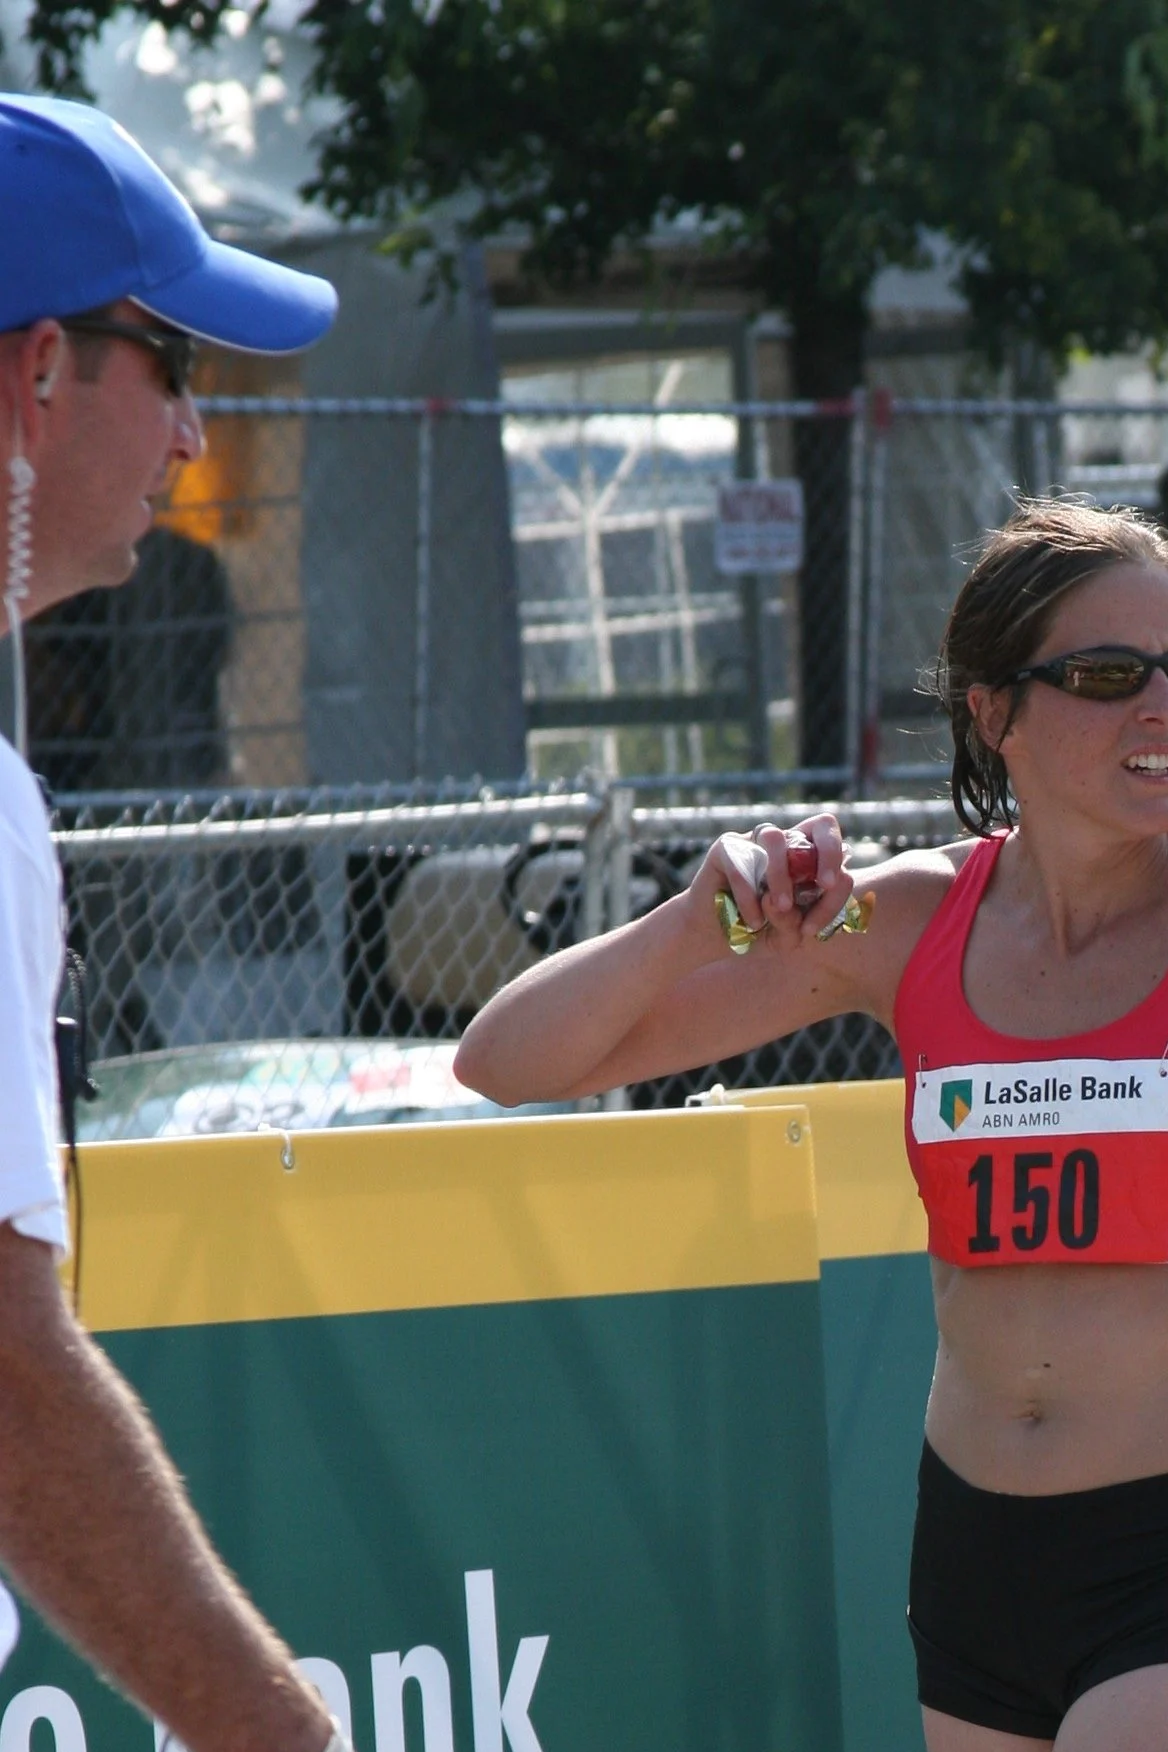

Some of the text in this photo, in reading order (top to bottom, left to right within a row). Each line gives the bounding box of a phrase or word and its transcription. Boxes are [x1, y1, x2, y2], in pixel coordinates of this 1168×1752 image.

[983, 1075, 1143, 1105] LaSalle Bank
[982, 1111, 1060, 1128] ABN AMRO
[967, 1148, 1100, 1253] 150
